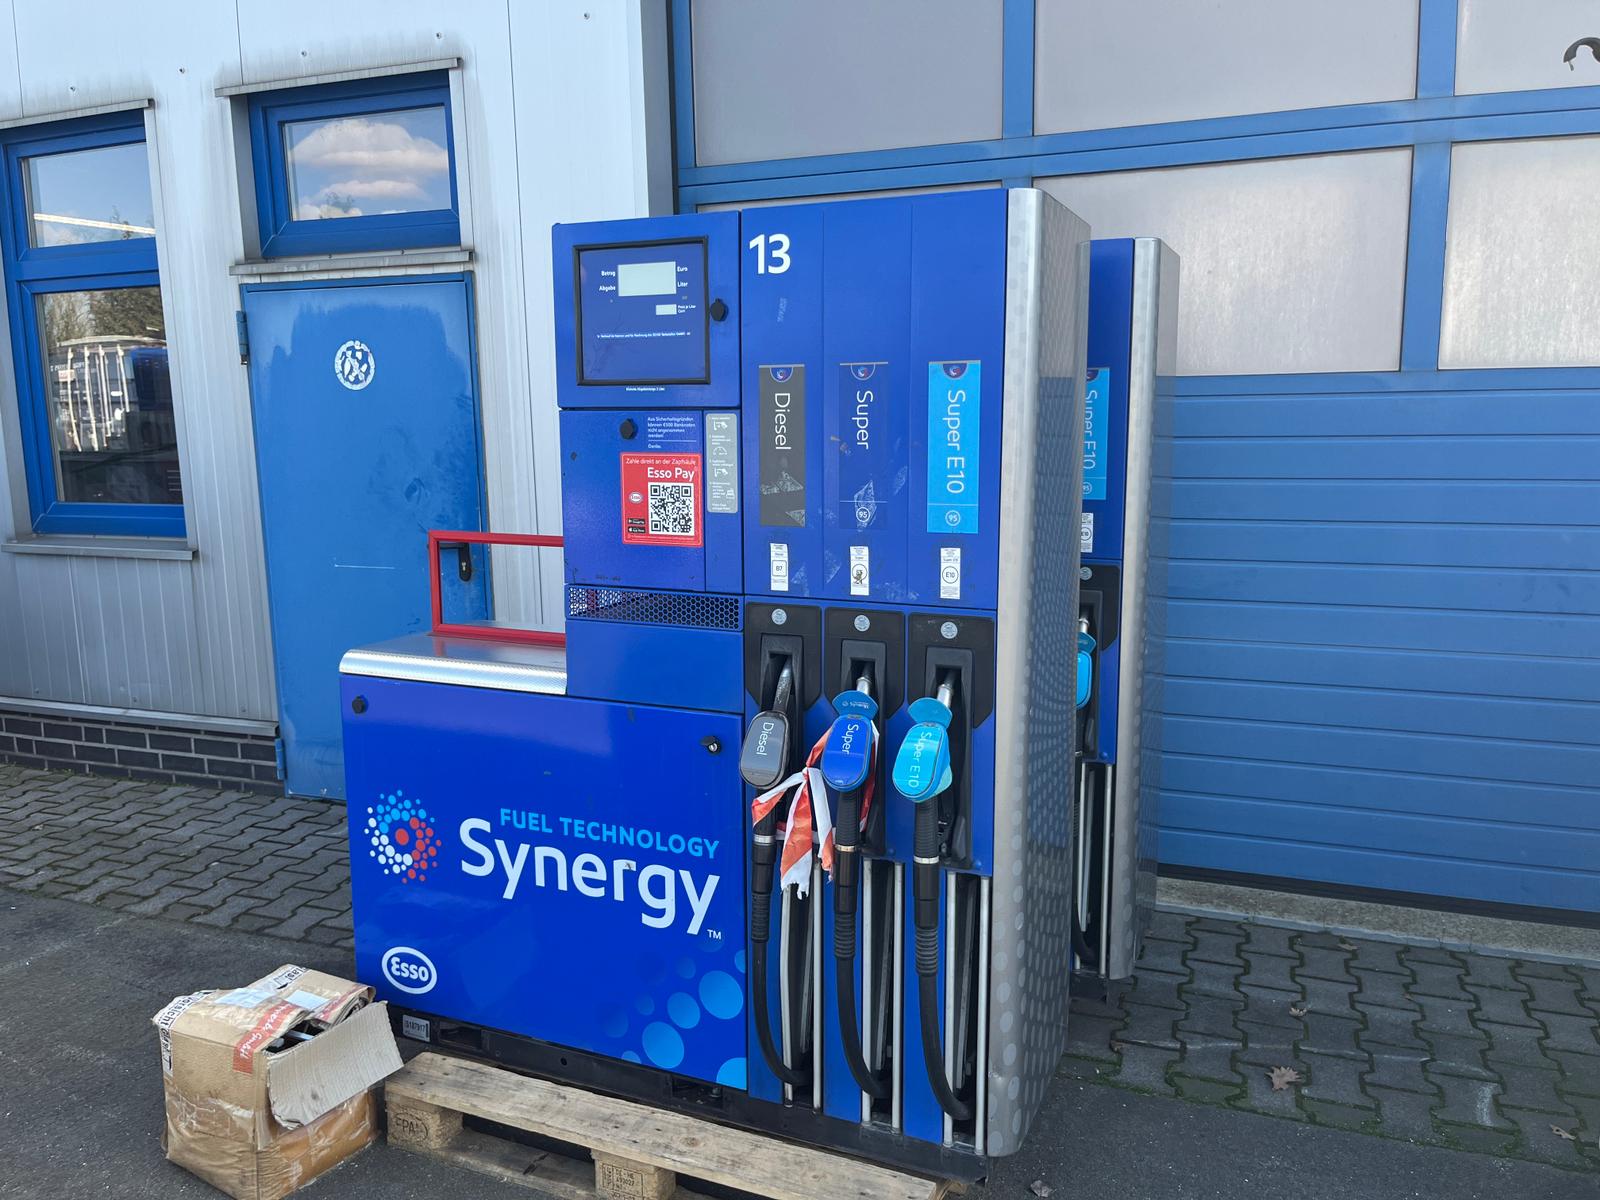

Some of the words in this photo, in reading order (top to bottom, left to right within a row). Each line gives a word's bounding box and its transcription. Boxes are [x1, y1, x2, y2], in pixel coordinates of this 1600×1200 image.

[749, 233, 791, 275] 13
[599, 285, 616, 293] Abgabe
[774, 392, 792, 450] Diesel
[852, 390, 874, 450] Super
[942, 390, 966, 451] Super
[648, 467, 673, 478] Esso
[675, 467, 695, 482] Pay
[946, 456, 966, 494] E10
[858, 510, 868, 519] 95
[949, 514, 958, 523] 95
[755, 722, 775, 756] Diesel
[842, 724, 859, 755] Super
[914, 731, 933, 763] Super
[906, 765, 921, 788] E10
[500, 808, 553, 834] FUEL
[559, 817, 720, 860] TECHNOLOGY
[459, 817, 721, 936] Synergy
[390, 957, 430, 981] Esso
